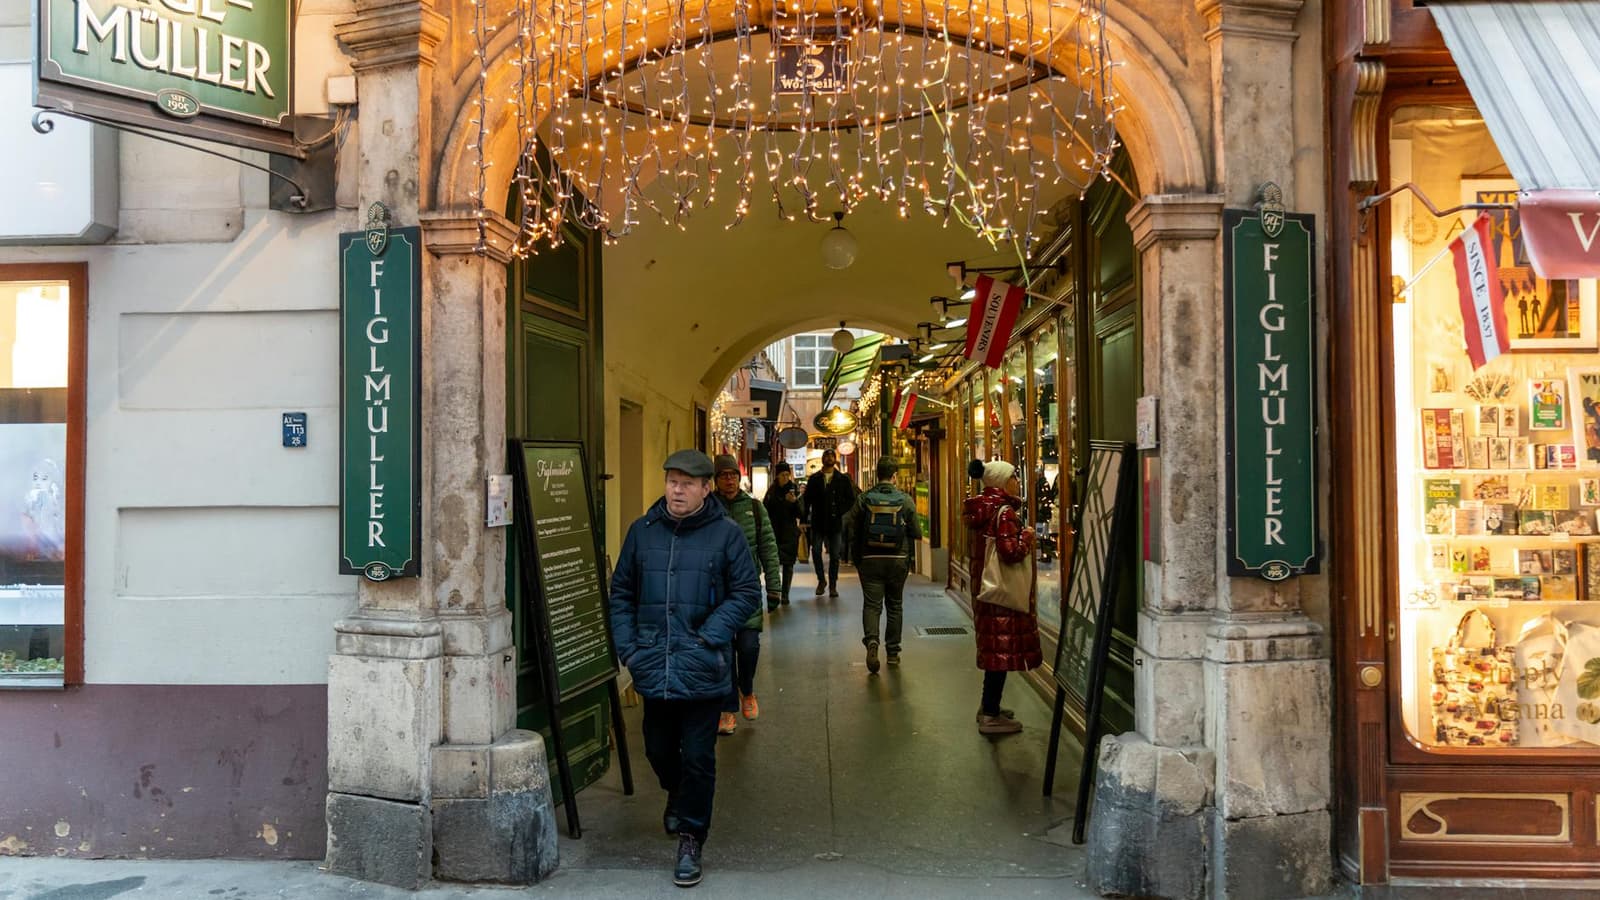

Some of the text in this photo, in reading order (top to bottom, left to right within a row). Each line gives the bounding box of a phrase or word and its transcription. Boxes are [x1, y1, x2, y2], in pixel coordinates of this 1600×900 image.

[71, 0, 275, 98] MÜLLER
[796, 47, 825, 79] 5
[168, 100, 189, 113] 1905
[976, 293, 1002, 353] SOUVENIRS
[1468, 241, 1493, 339] SINCE 1837
[363, 260, 392, 548] FIGLMÜLLER
[1257, 243, 1289, 546] FIGLMÜLLER
